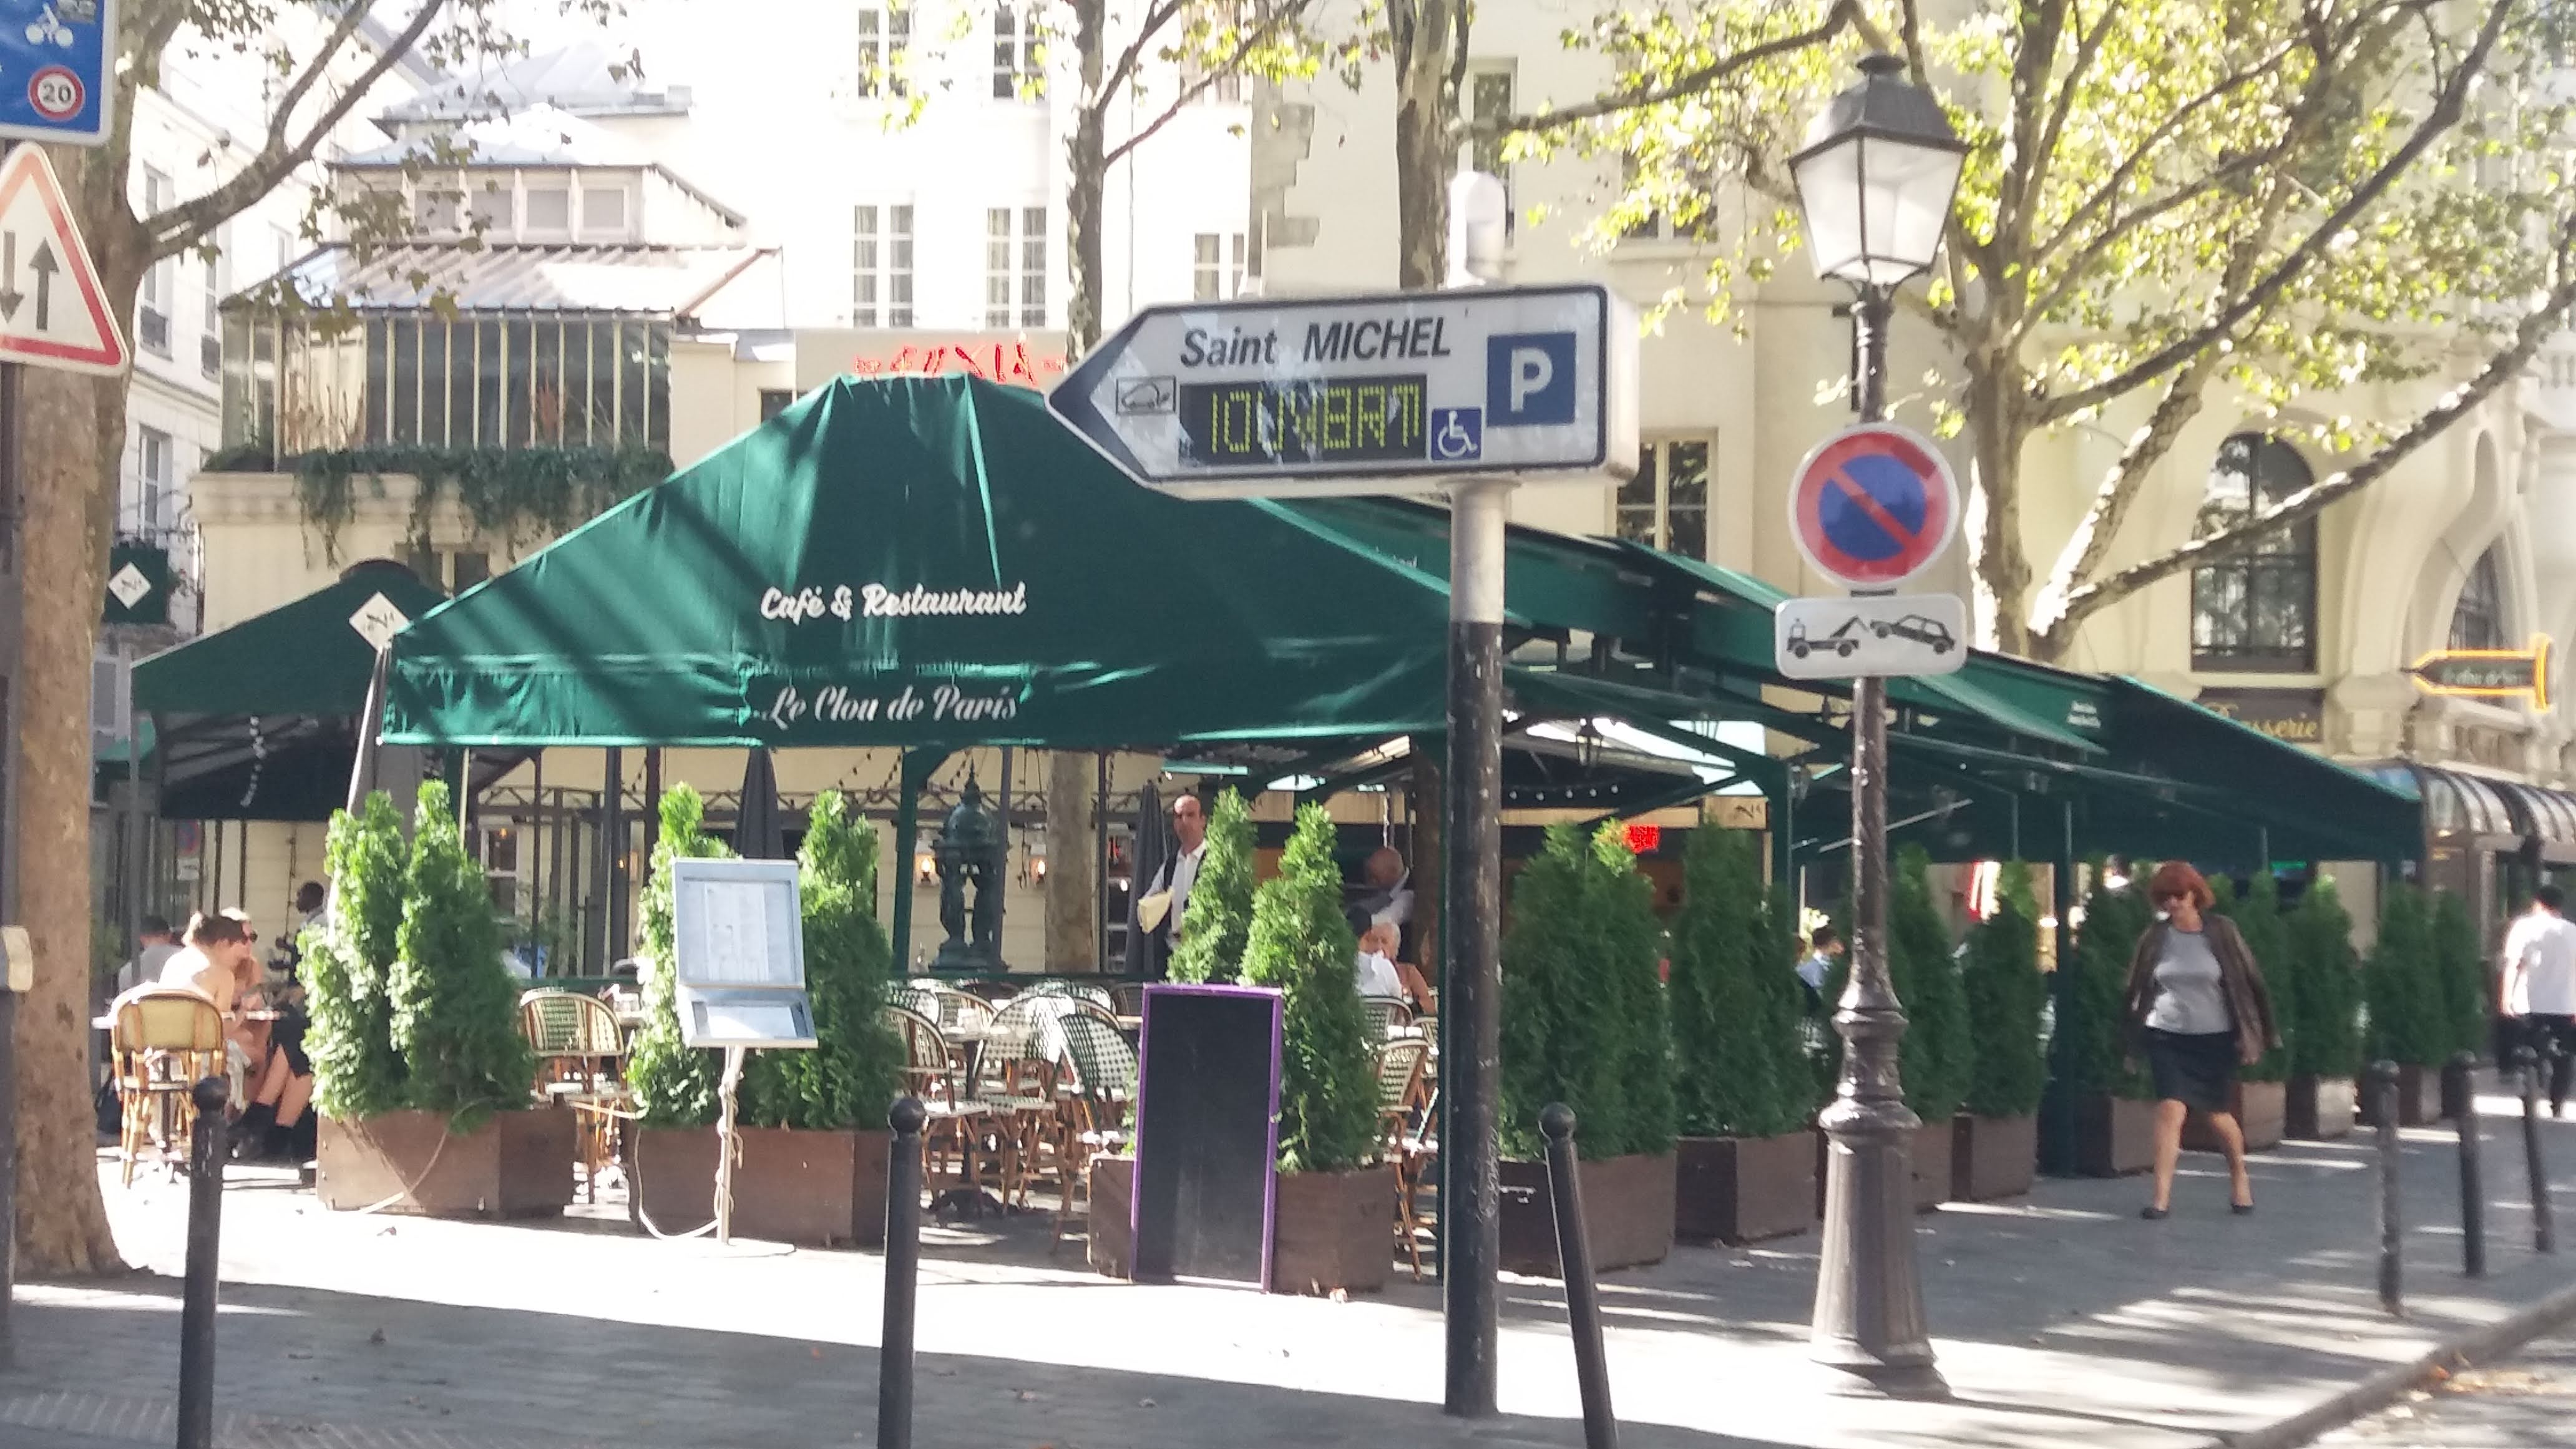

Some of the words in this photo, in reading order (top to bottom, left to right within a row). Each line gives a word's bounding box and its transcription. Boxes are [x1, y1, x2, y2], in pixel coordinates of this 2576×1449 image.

[42, 80, 72, 104] 20
[1181, 326, 1278, 368] Saint
[1303, 317, 1451, 362] MICHEL
[1510, 346, 1553, 412] P
[761, 585, 826, 625] Café
[831, 583, 852, 622] &
[861, 581, 1027, 617] Restaurant
[770, 685, 807, 729] Le
[814, 686, 879, 722] Clou
[886, 685, 924, 721] de
[932, 685, 1018, 721] Paris
